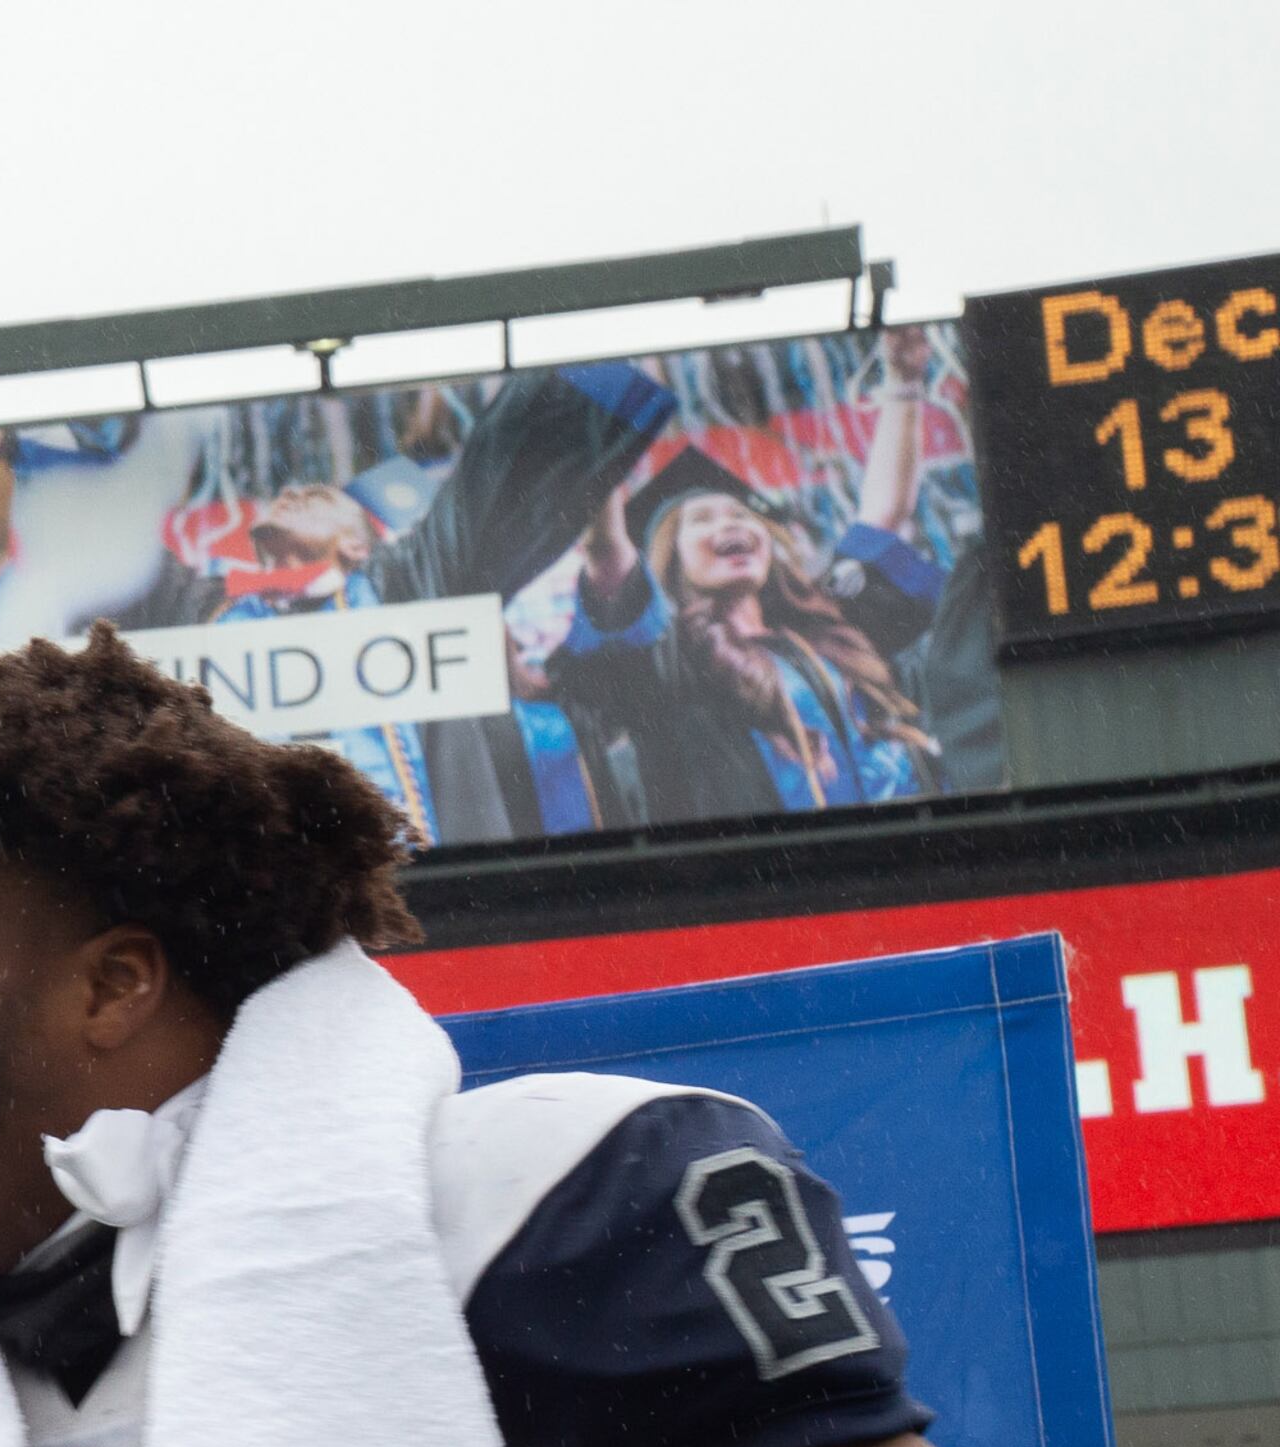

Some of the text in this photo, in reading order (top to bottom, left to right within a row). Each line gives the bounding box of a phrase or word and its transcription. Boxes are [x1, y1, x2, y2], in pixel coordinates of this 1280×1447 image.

[1042, 287, 1280, 386] Dec
[1095, 387, 1236, 490] 13
[1017, 494, 1280, 616] 12:3
[354, 627, 469, 699] OF
[674, 1147, 881, 1381] 2
